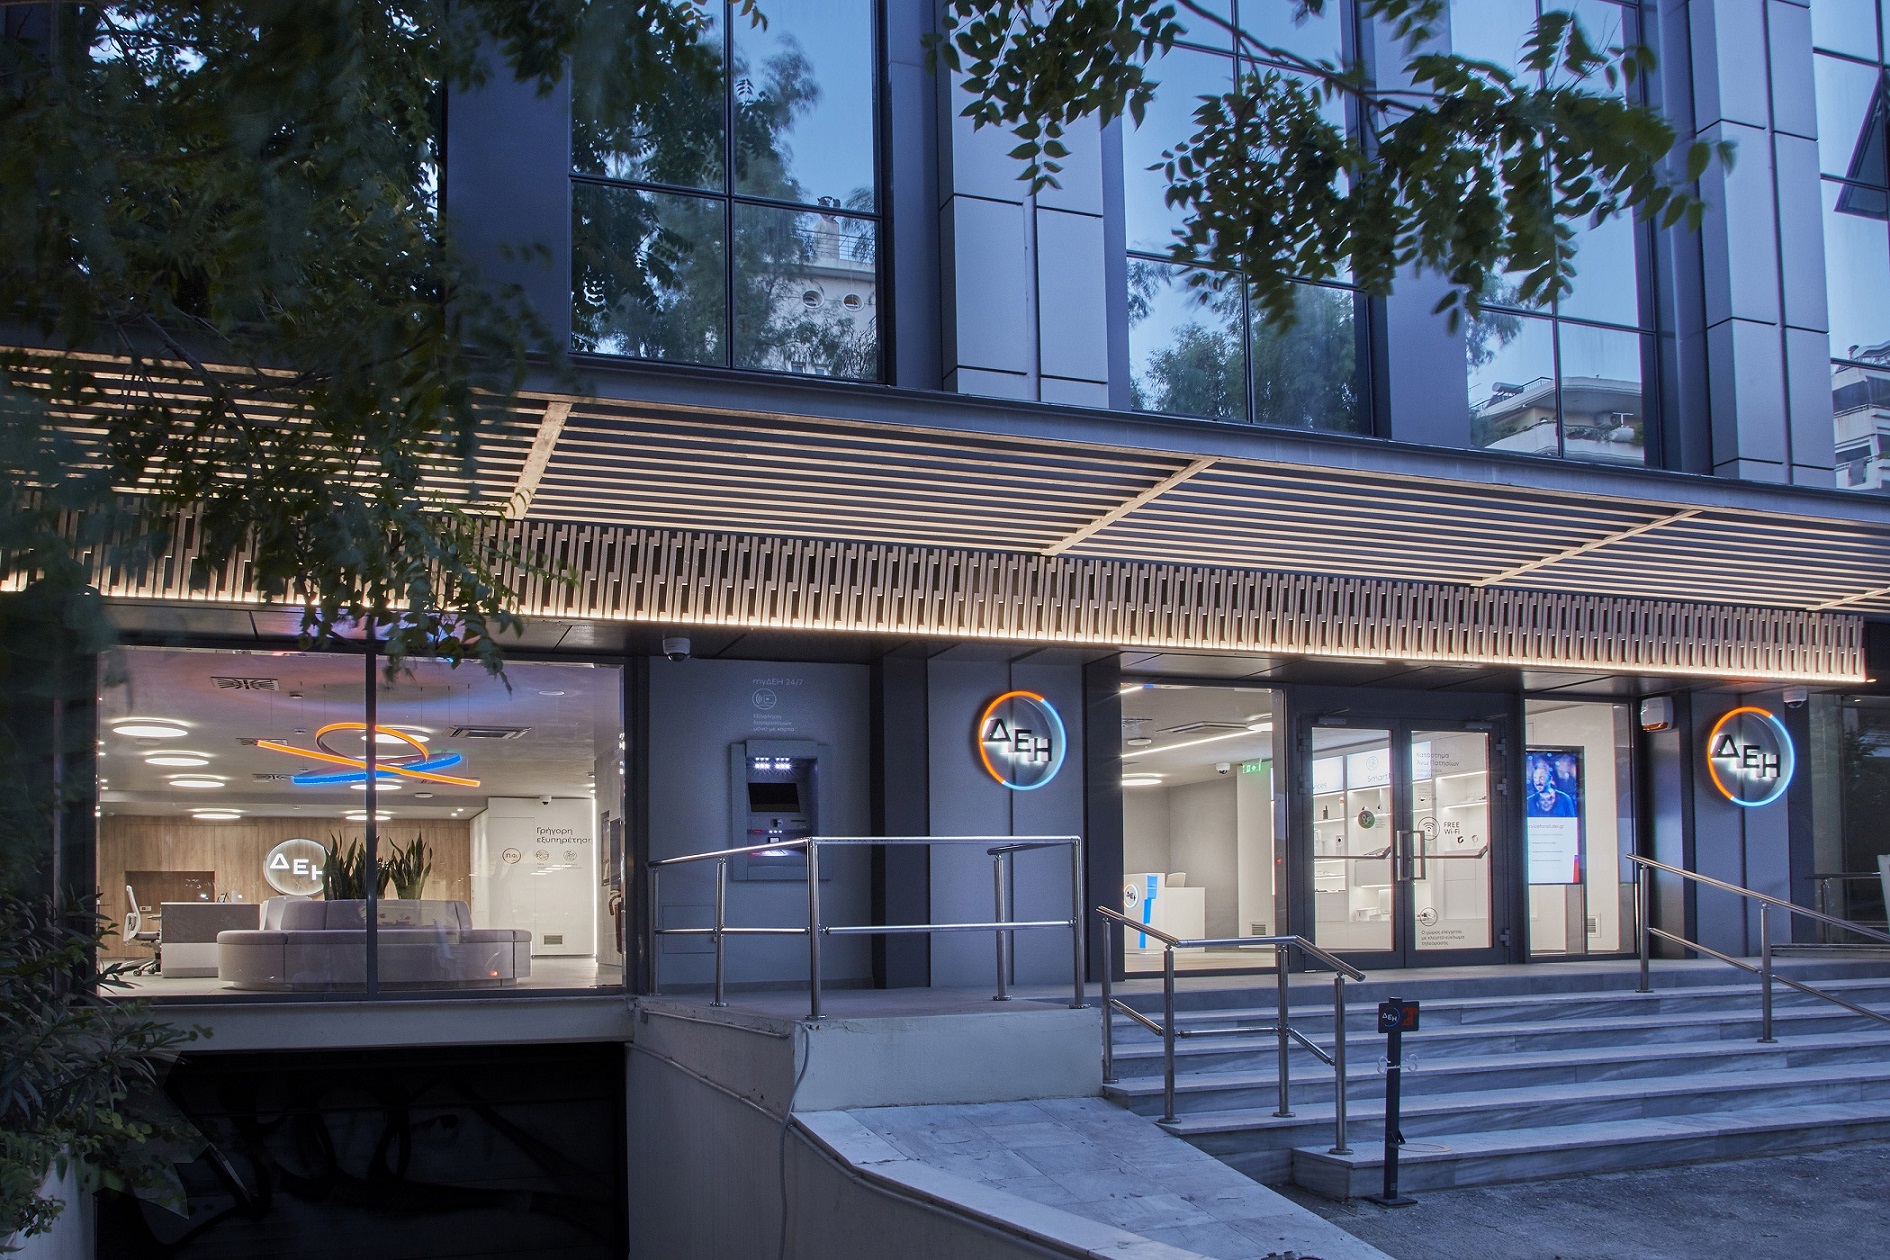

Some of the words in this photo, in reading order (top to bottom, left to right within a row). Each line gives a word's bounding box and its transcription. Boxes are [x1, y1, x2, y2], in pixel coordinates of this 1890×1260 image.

[985, 717, 1053, 763] ΔΕΗ
[1714, 733, 1781, 779] ΔΕΗ
[536, 826, 573, 836] Γρήγορη
[1381, 1012, 1398, 1022] ΔΕΗ
